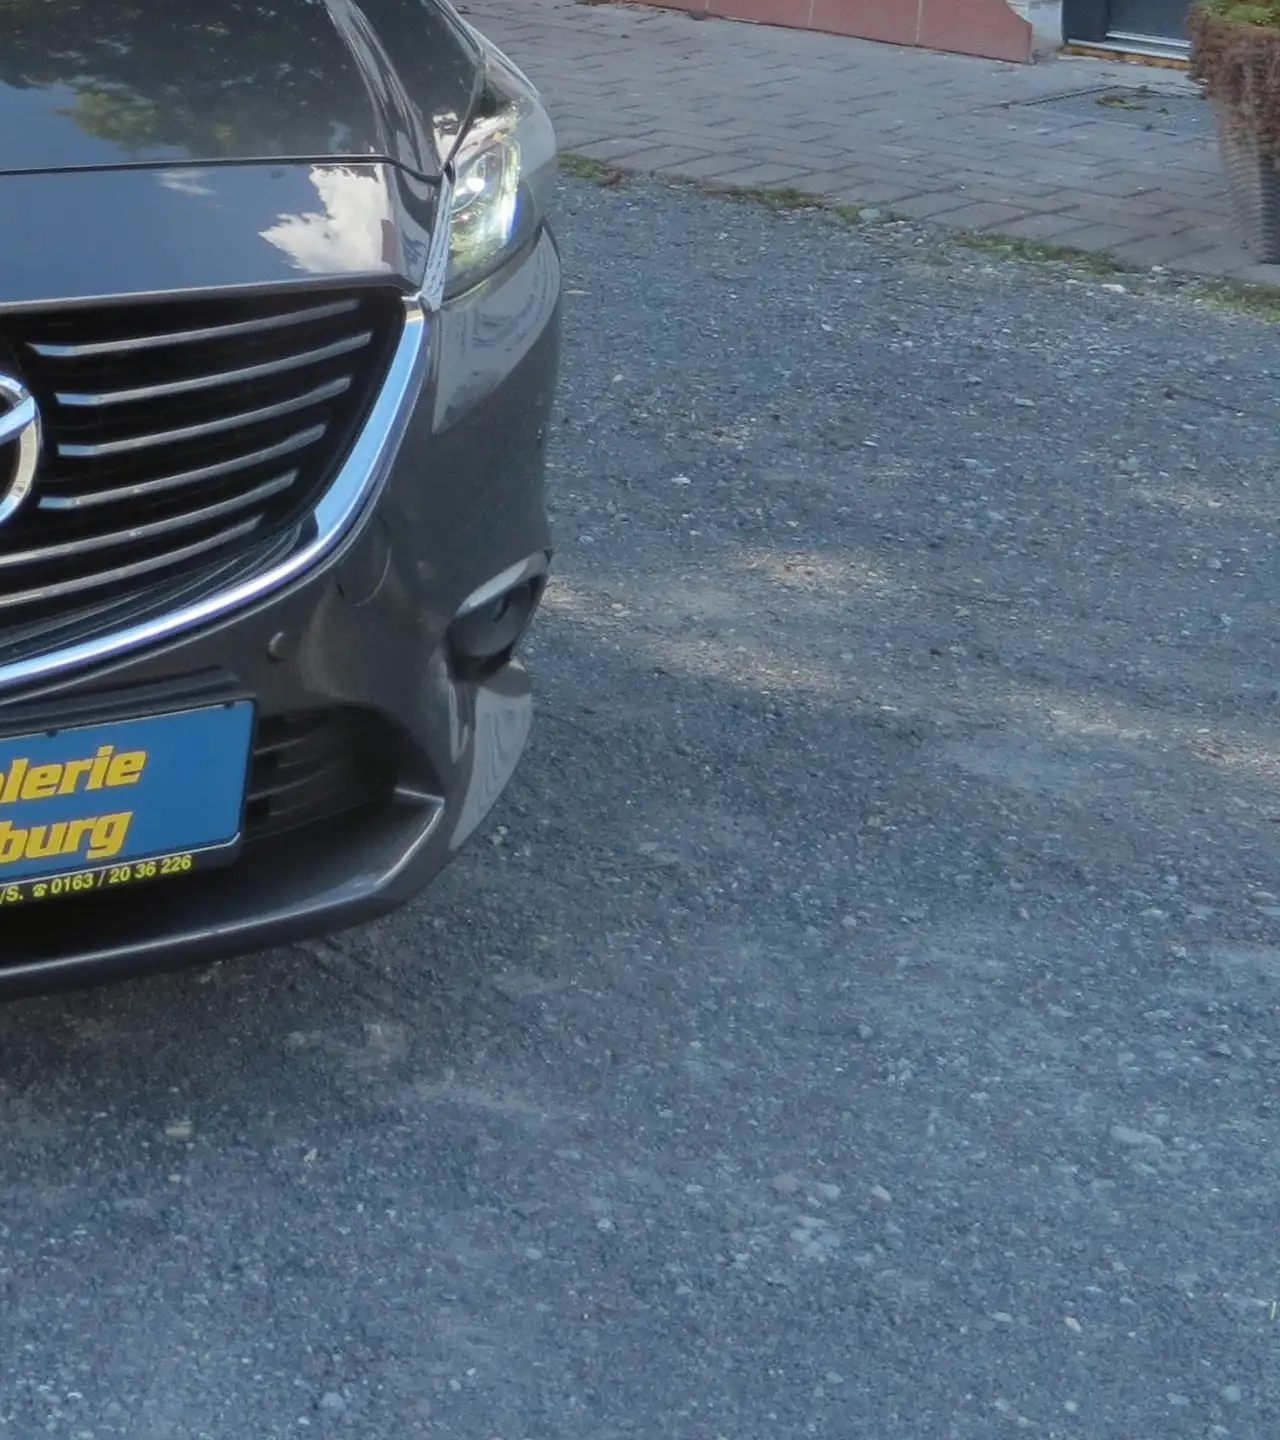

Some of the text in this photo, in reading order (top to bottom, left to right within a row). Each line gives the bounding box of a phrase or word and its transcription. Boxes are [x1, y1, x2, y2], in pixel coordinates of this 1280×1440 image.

[51, 872, 93, 894] 0163
[109, 865, 131, 884] 20
[134, 860, 157, 879] 36
[160, 854, 193, 875] 226
